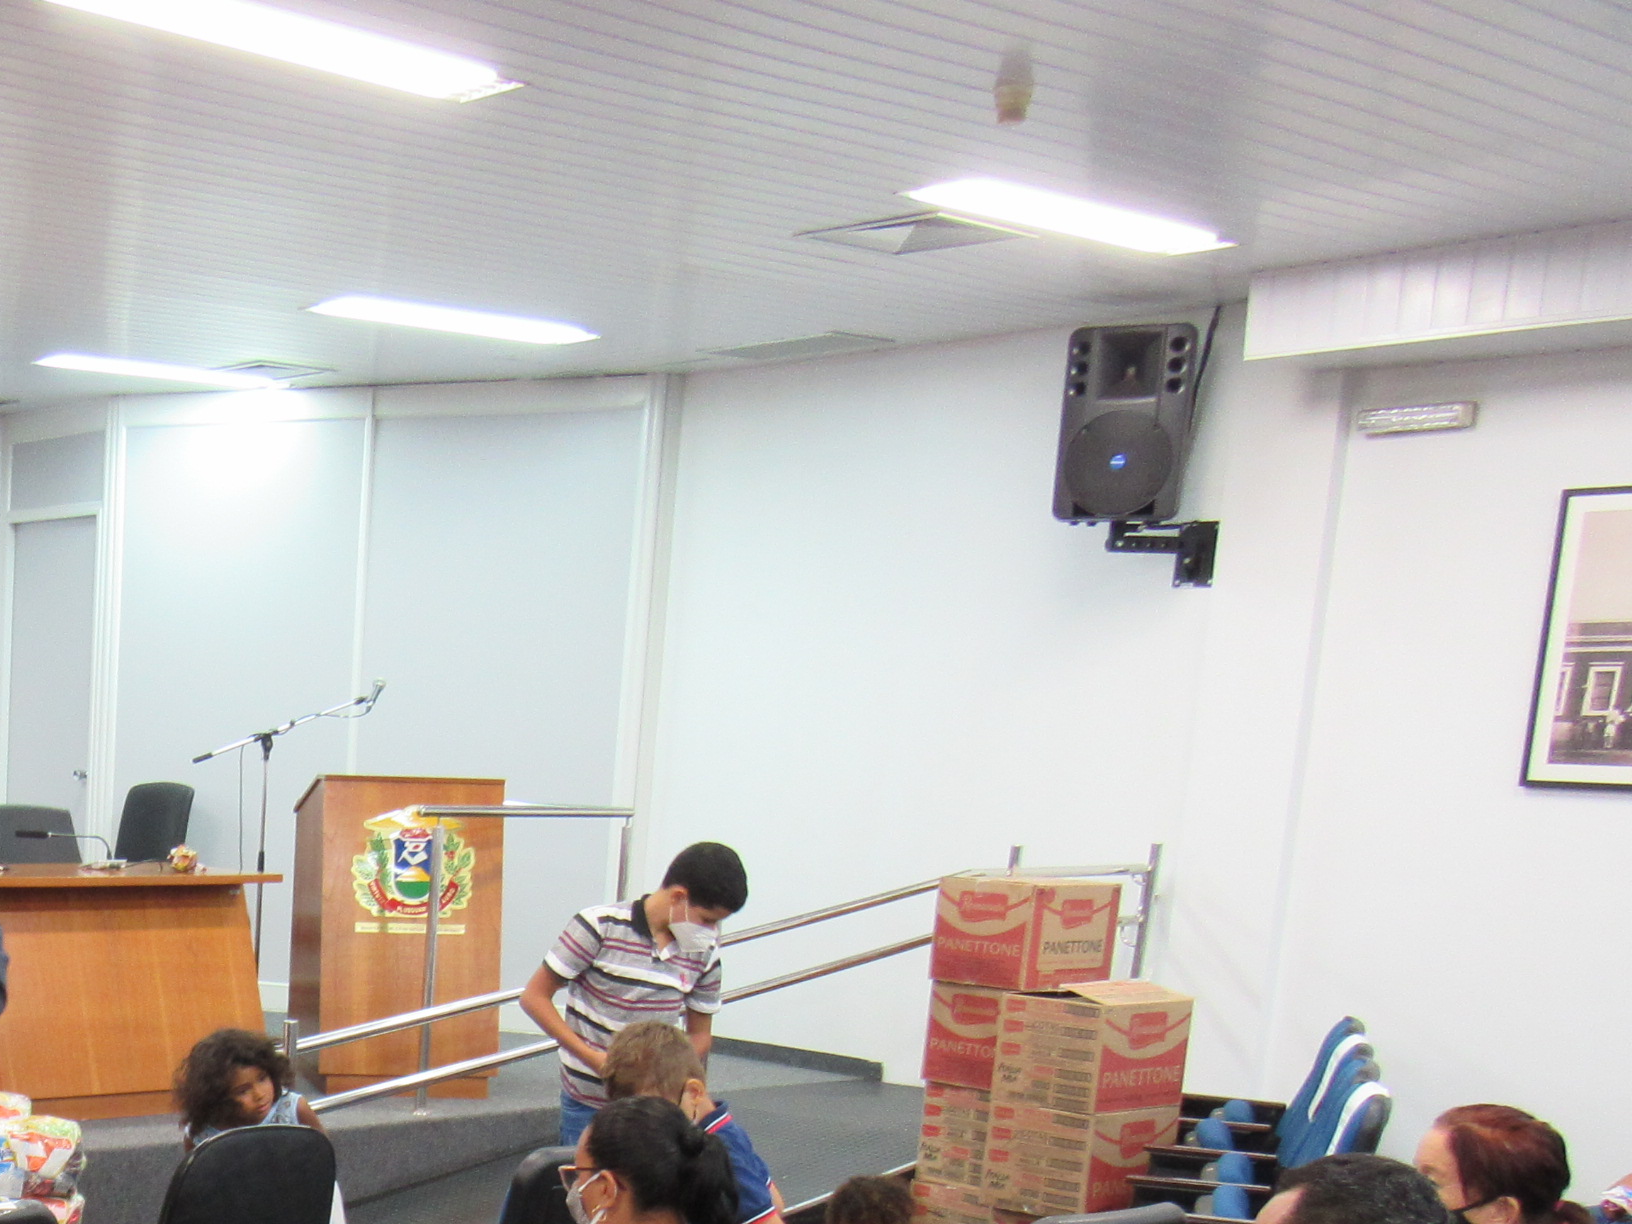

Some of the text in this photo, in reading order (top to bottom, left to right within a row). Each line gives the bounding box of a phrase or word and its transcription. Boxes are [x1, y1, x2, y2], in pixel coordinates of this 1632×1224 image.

[937, 937, 1021, 957] PANETTONE
[1042, 939, 1103, 955] PANETTONE
[930, 1037, 995, 1059] PANETTO
[1101, 1065, 1181, 1088] PANETTONE
